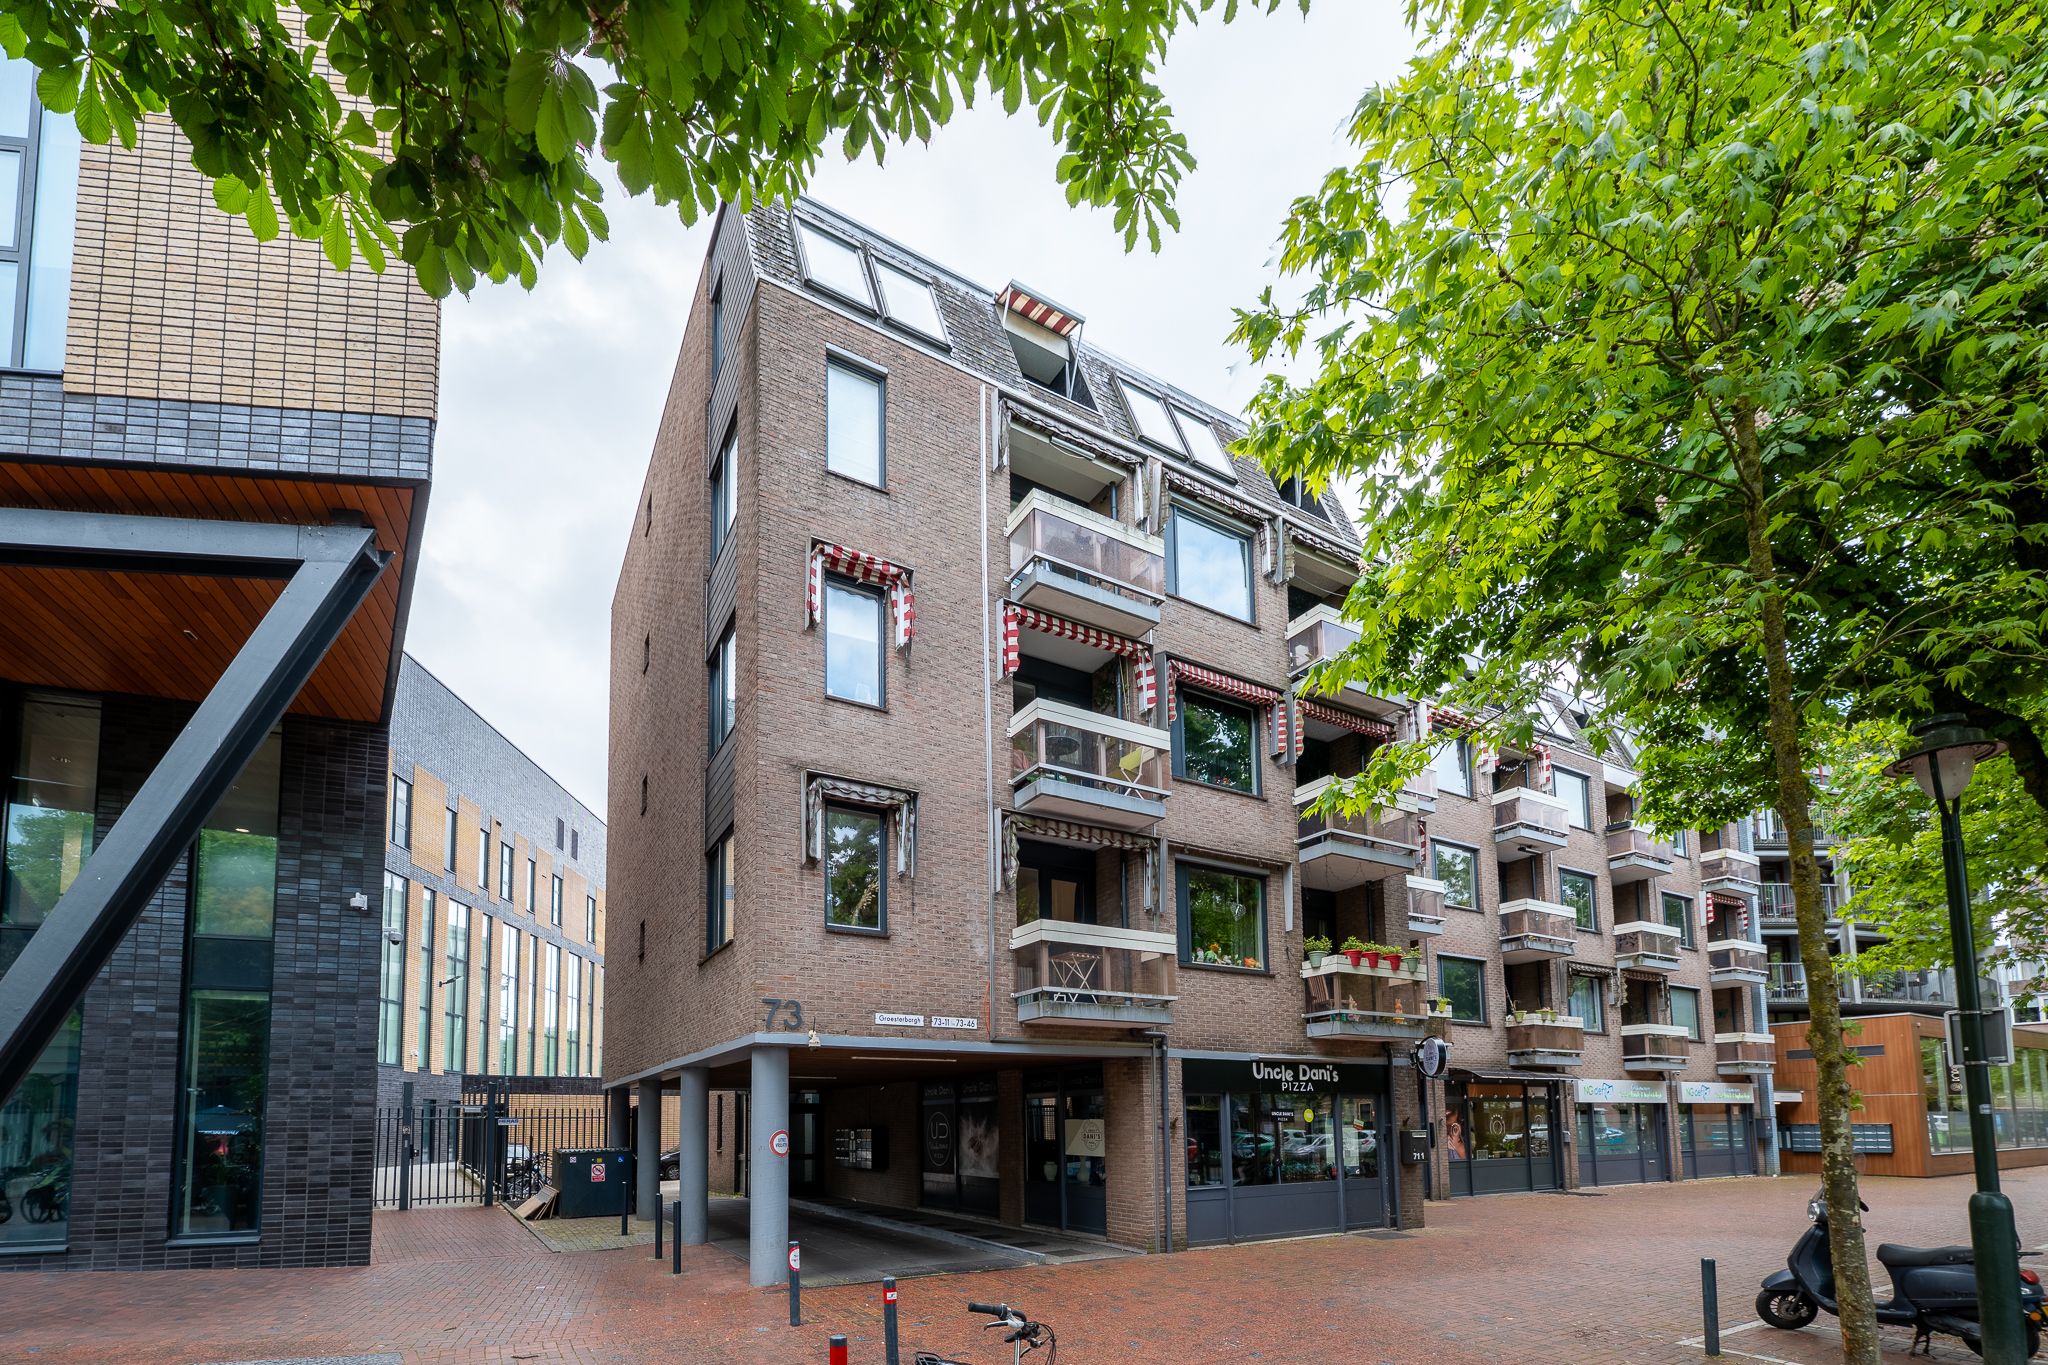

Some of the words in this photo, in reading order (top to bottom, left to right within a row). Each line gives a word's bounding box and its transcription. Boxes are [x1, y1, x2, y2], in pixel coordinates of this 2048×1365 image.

[762, 998, 802, 1029] 73
[1252, 1062, 1293, 1081] Uncle
[1299, 1064, 1339, 1082] Dani's
[1281, 1082, 1314, 1092] PIZZA
[930, 1121, 949, 1140] UD
[1413, 1152, 1425, 1161] 711
